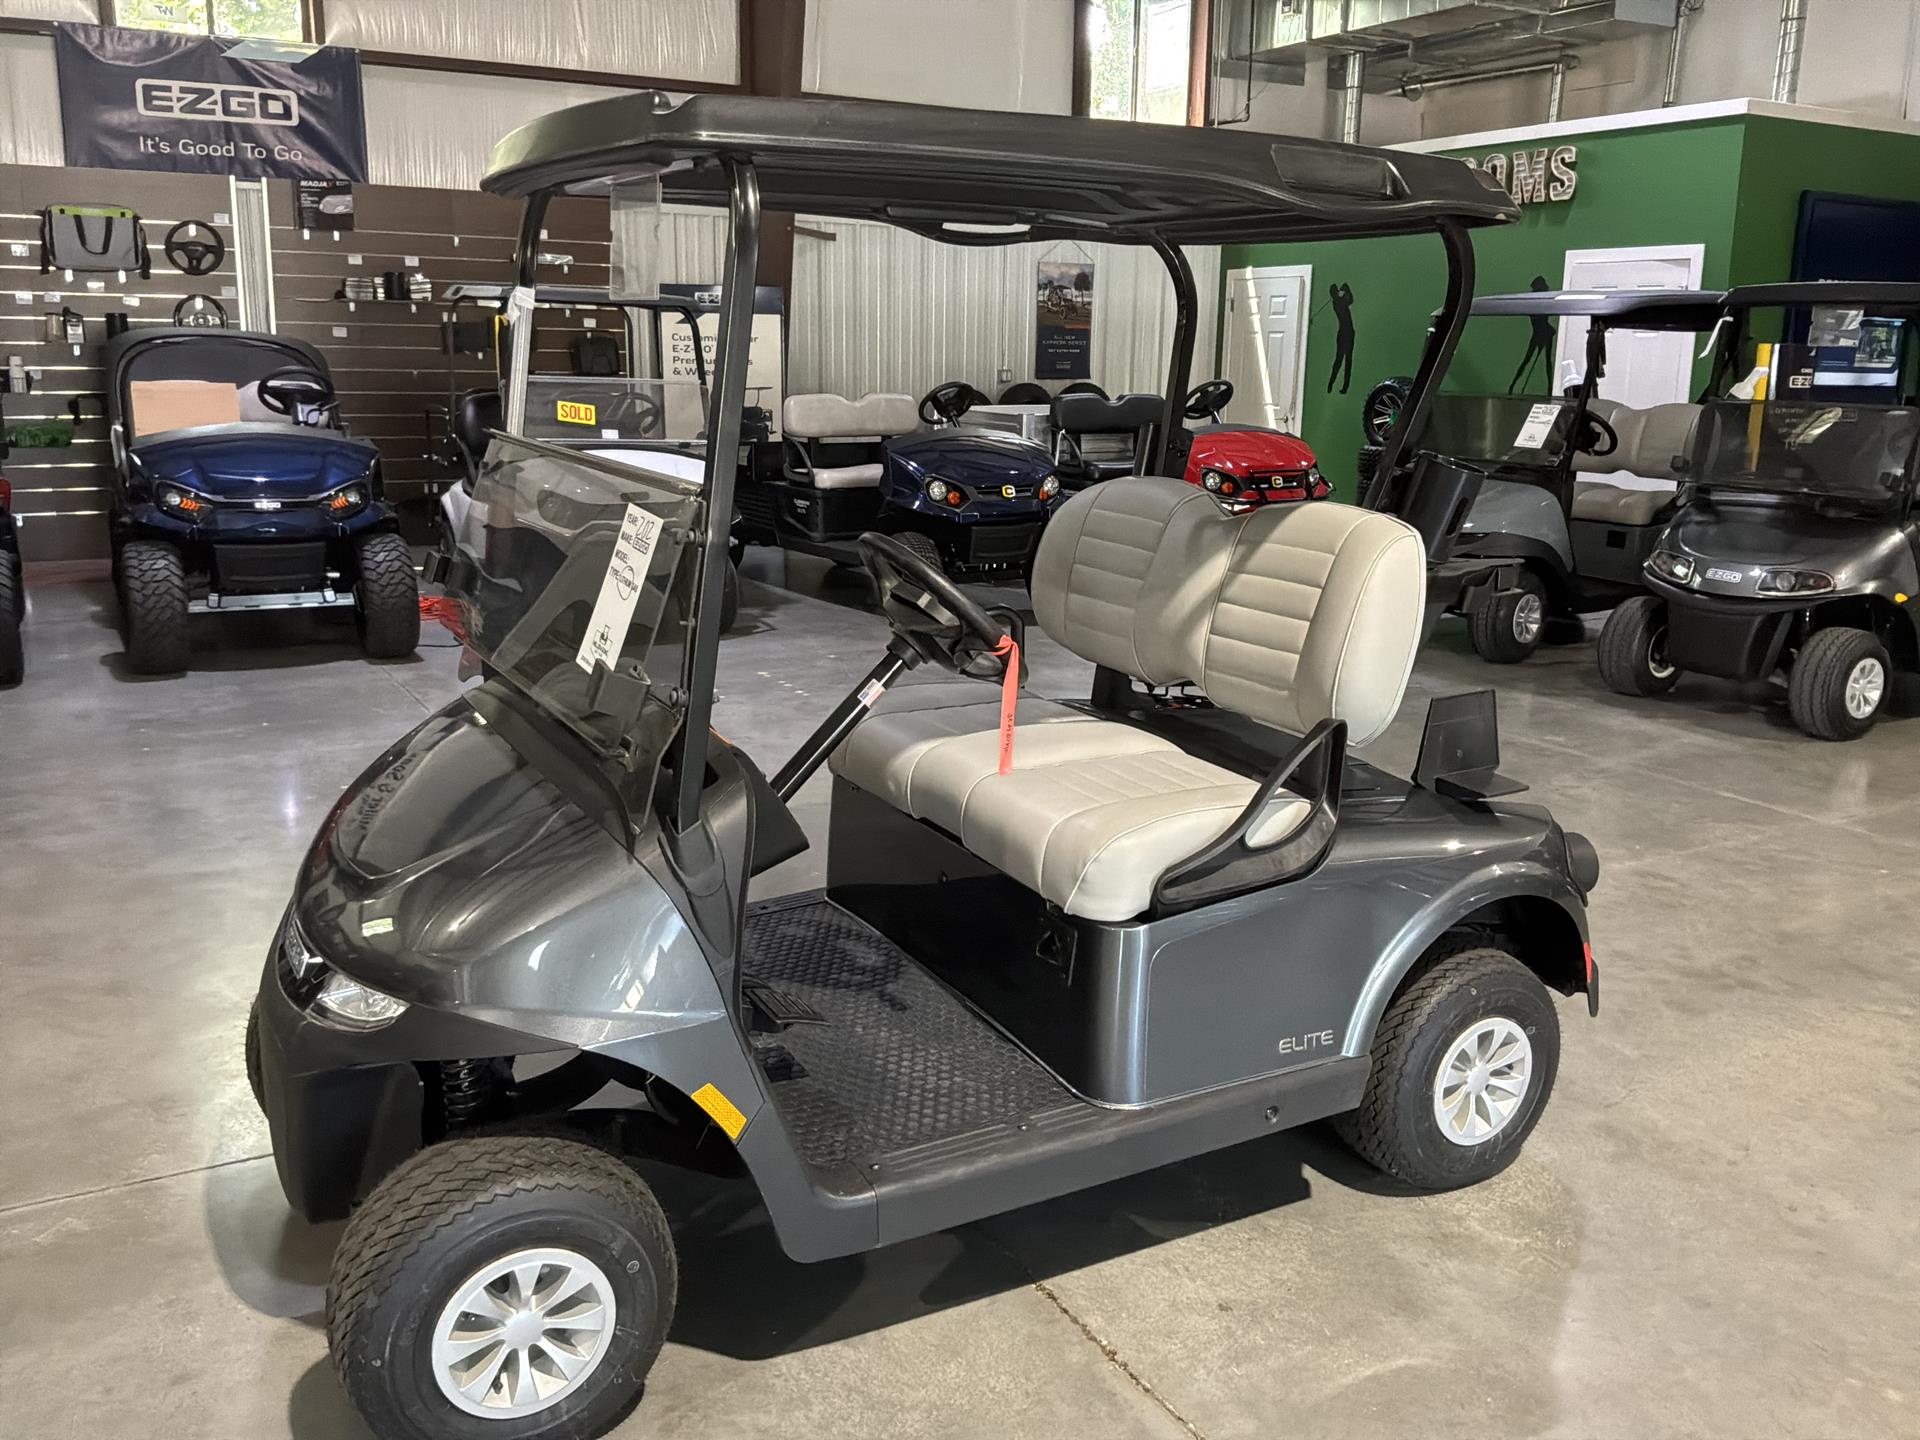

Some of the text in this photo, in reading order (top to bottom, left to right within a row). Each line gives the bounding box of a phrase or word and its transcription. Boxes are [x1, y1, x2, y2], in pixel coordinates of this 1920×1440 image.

[140, 81, 294, 123] EZGO
[138, 136, 303, 162] It's Good To Go
[1461, 145, 1577, 204] OMS
[696, 293, 720, 304] EZ
[672, 344, 712, 354] E-Z-O
[672, 367, 682, 376] &
[560, 404, 593, 421] SOLD
[1707, 569, 1741, 583] EZGO
[1278, 1029, 1334, 1055] ELITE
